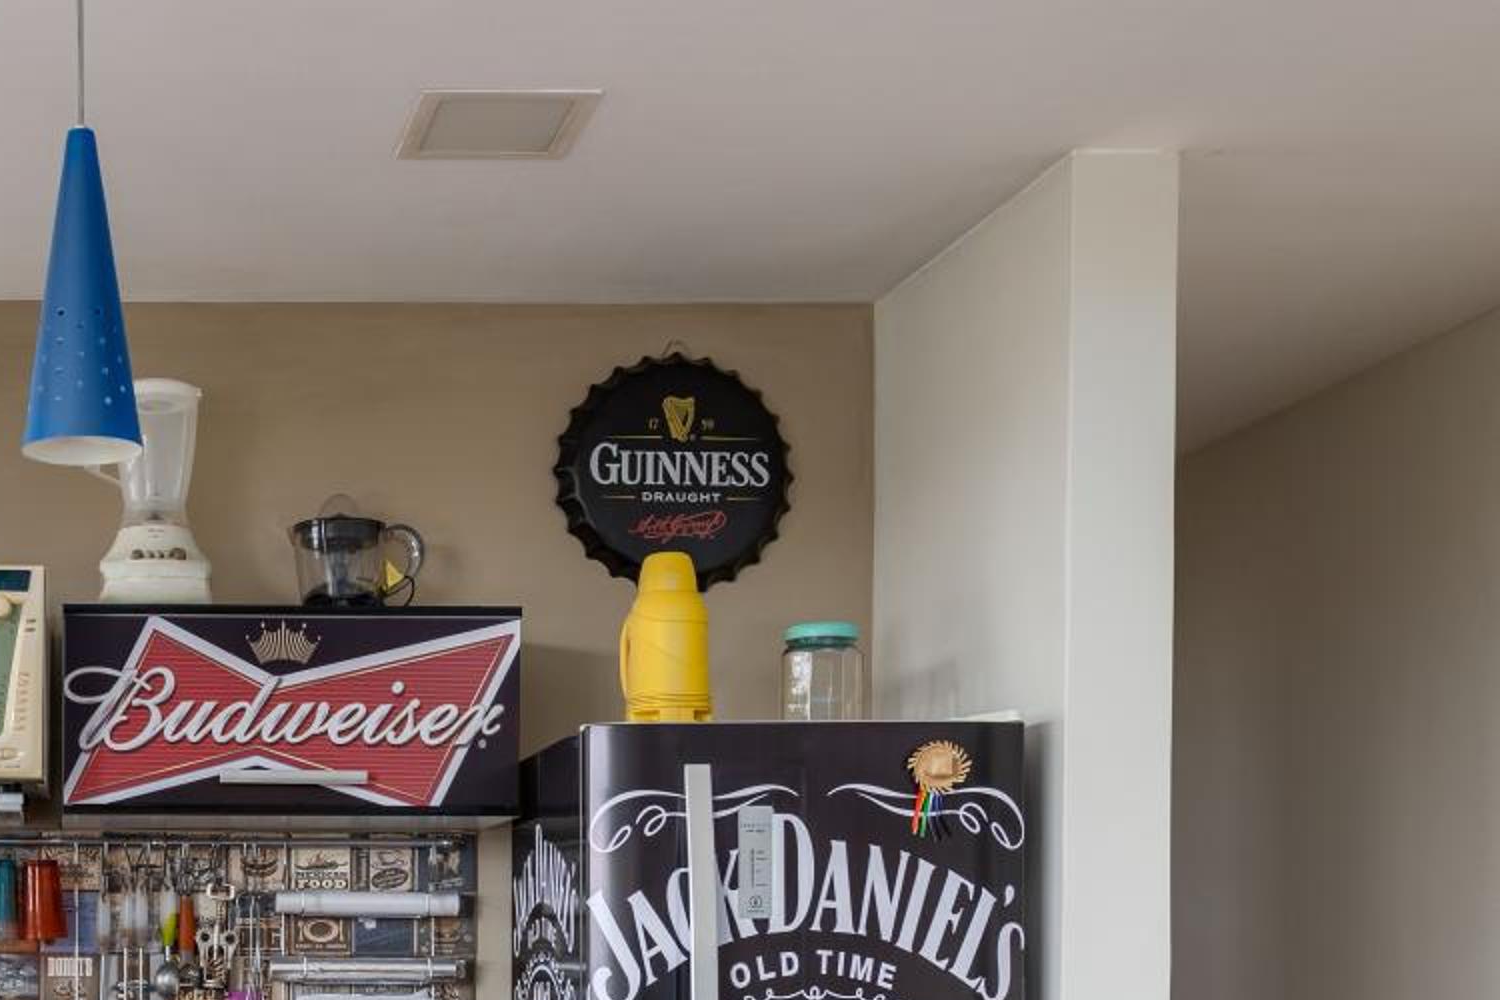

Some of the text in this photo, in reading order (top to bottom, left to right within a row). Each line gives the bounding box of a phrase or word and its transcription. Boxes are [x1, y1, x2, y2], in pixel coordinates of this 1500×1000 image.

[589, 442, 771, 487] GUINNESS
[641, 491, 721, 503] DRAUGHT
[64, 666, 505, 752] Budweiser
[730, 949, 896, 990] OLD TIME
